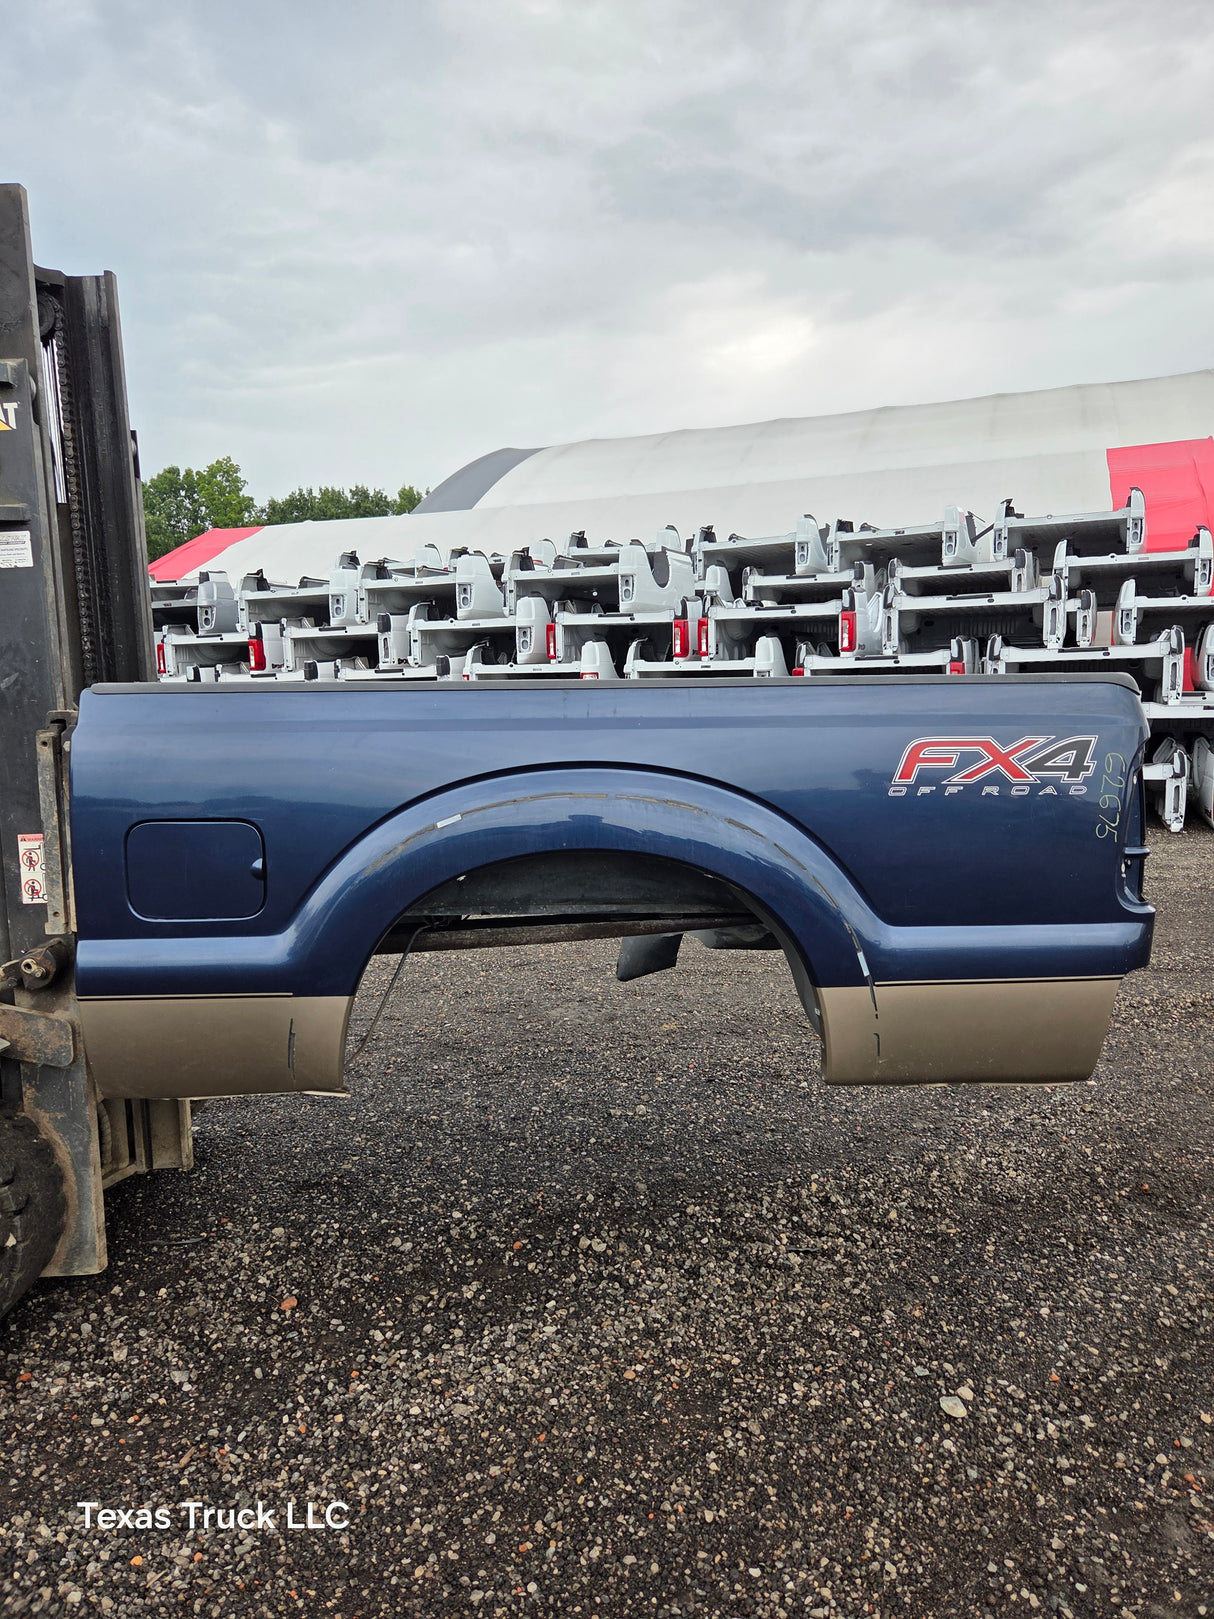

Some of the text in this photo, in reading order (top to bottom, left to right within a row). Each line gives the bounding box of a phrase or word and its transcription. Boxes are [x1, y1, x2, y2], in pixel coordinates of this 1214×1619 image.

[891, 735, 1099, 784] FX4
[888, 785, 1088, 796] OFF ROAD
[1095, 752, 1126, 843] 62675
